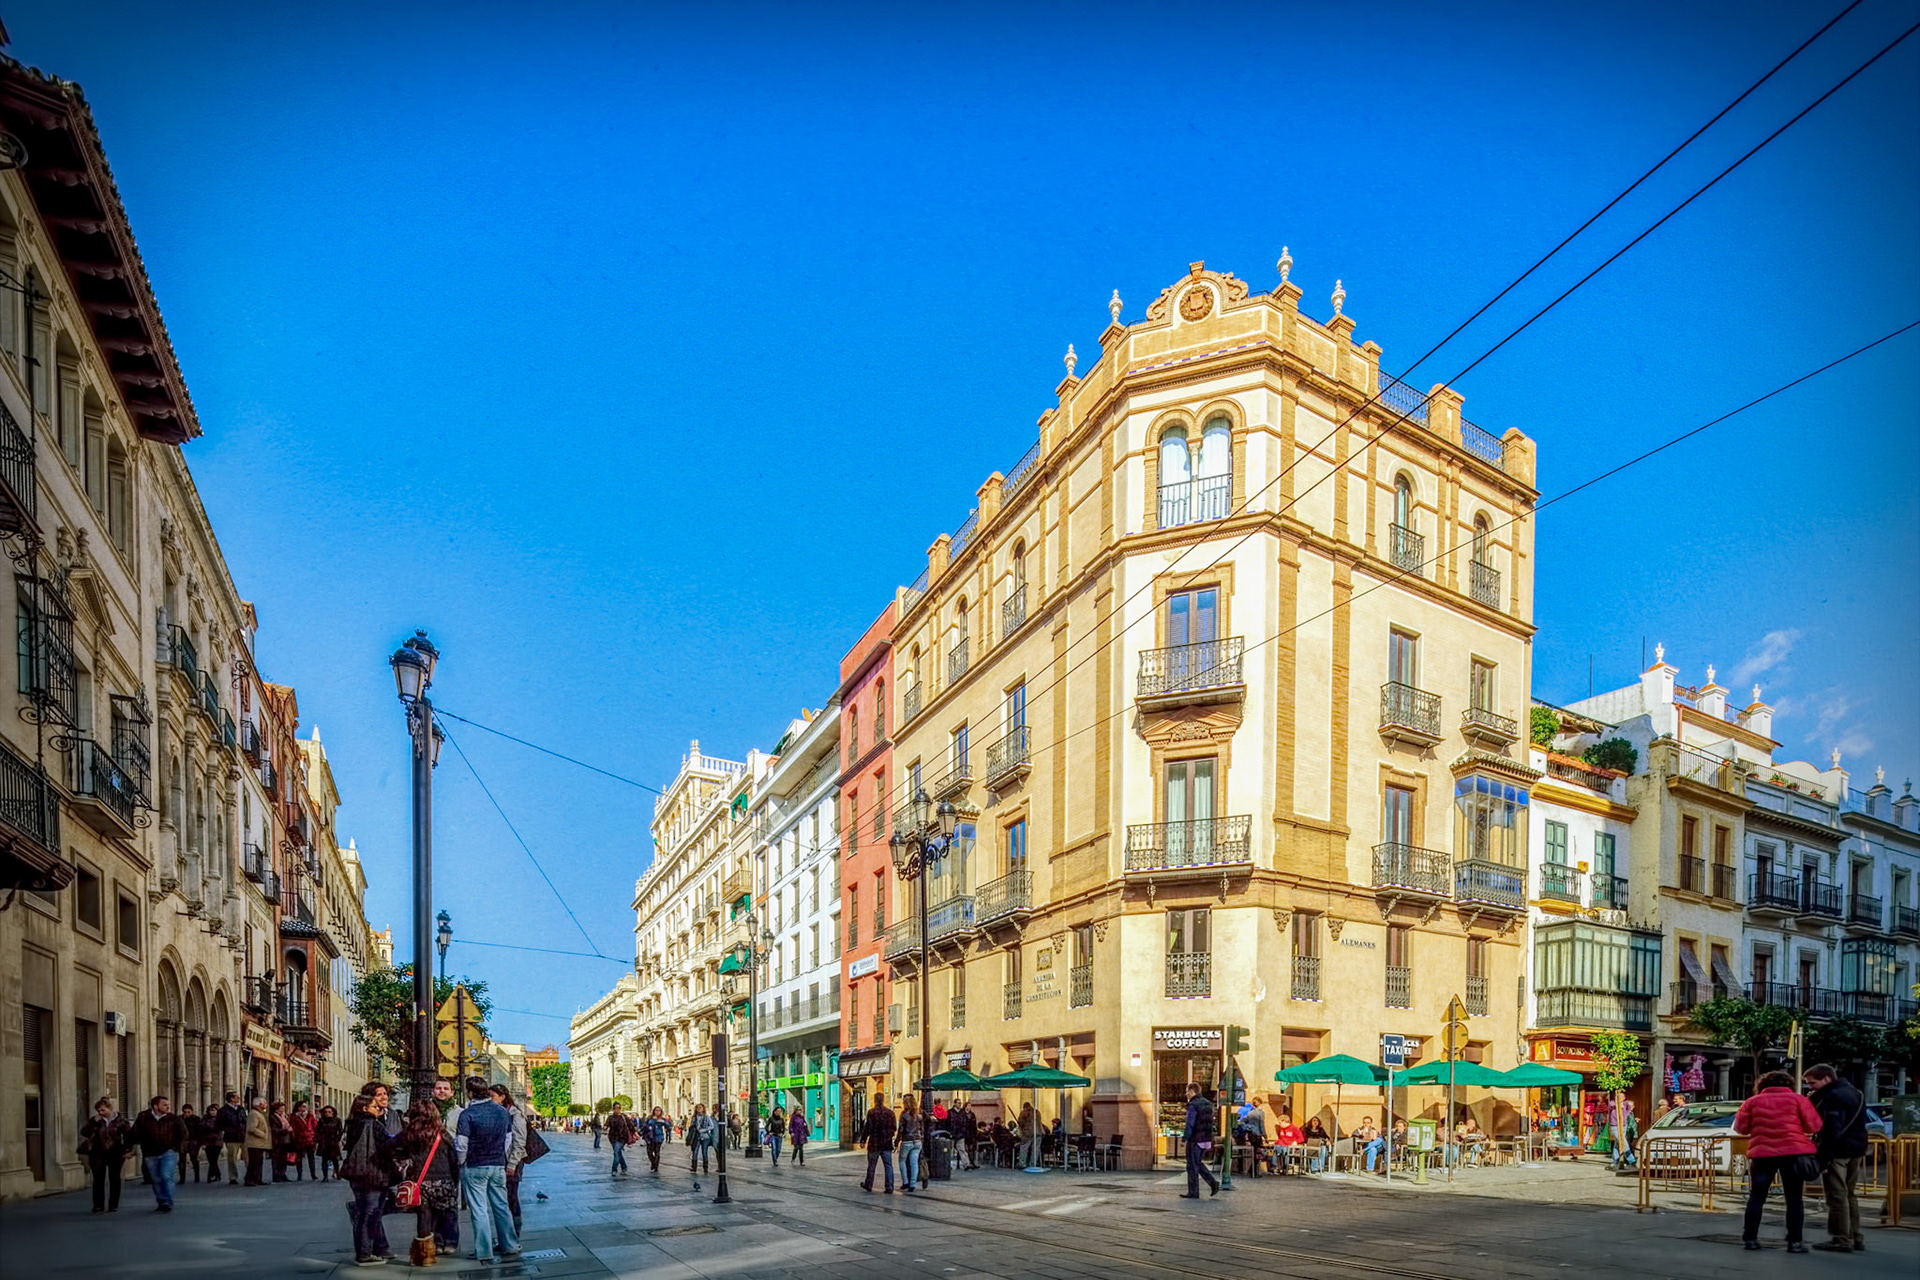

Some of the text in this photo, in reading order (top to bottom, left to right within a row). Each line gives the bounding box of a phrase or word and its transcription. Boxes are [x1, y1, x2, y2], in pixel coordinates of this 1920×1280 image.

[1340, 938, 1376, 948] ALEMANES
[1044, 982, 1052, 990] LA
[1155, 1030, 1222, 1039] STARBUCKS
[1167, 1038, 1209, 1048] COFFEE
[1385, 1045, 1403, 1055] TAXI
